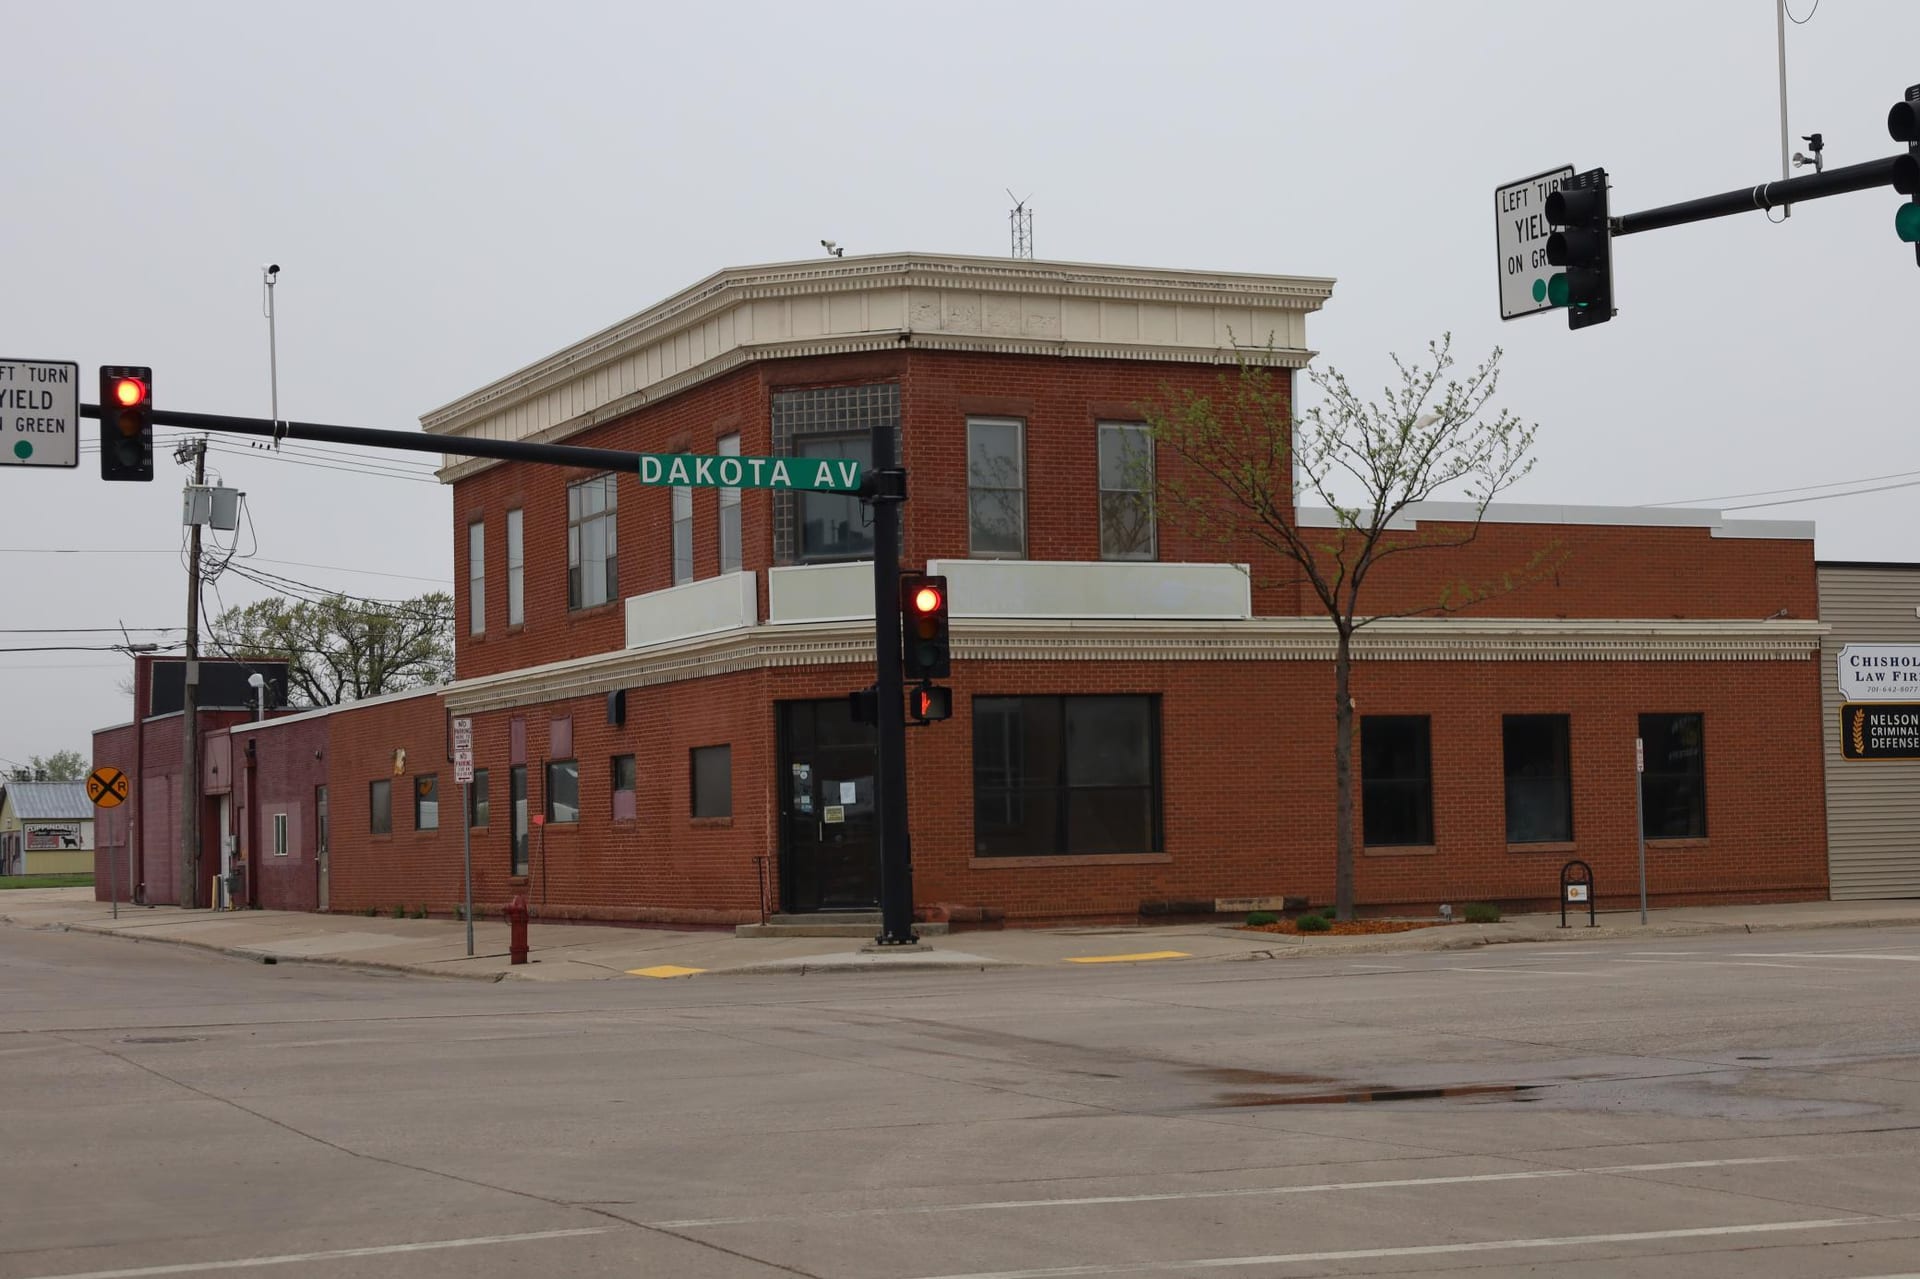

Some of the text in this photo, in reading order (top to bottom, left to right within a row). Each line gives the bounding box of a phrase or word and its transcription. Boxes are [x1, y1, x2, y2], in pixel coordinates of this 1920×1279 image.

[1503, 188, 1528, 213] LEFT
[1515, 213, 1557, 244] YIEL
[1508, 254, 1523, 275] ON
[0, 366, 68, 383] FT TURN
[0, 389, 53, 410] YIELD
[16, 417, 65, 433] GREEN
[641, 456, 858, 488] DAKOTA AV
[1850, 655, 1920, 667] CHISHOL
[1856, 671, 1920, 682] LAW FIR
[458, 720, 467, 728] NO
[1870, 714, 1919, 726] NELSON
[1871, 727, 1919, 736] CRIMINAL
[1871, 738, 1920, 749] DEFENSE
[90, 781, 126, 793] R R
